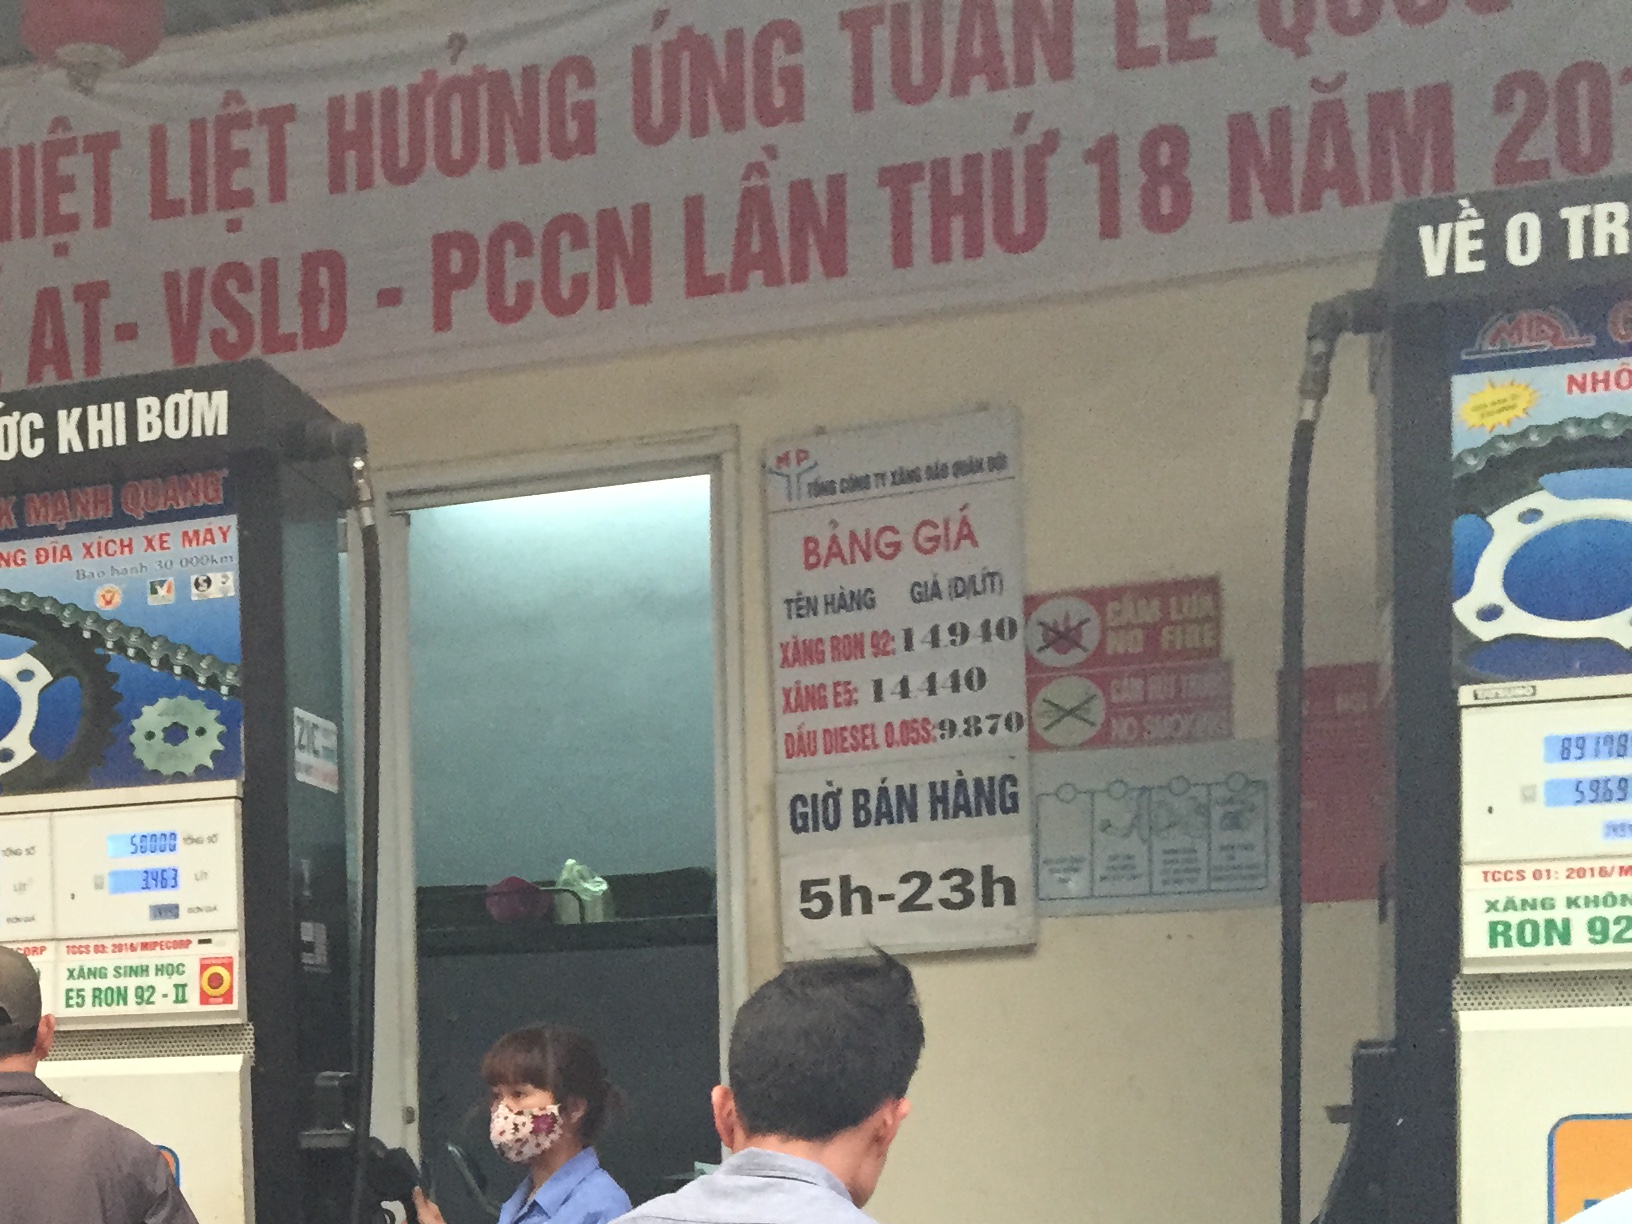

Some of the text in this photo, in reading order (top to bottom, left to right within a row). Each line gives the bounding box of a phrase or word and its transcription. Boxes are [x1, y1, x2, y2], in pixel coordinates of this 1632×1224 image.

[148, 88, 296, 234] LIỆT
[327, 32, 596, 196] HƯỞNG
[631, 8, 805, 147] ỨNG
[162, 248, 348, 367] VSLĐ
[432, 201, 652, 333] PCCN
[683, 143, 848, 300] LẦN
[876, 109, 1061, 270] THỨ
[1082, 122, 1193, 241] 18
[1227, 71, 1456, 223] NĂM
[1419, 197, 1487, 277] VỀ
[57, 401, 126, 454] KHI
[136, 388, 229, 443] BƠM
[120, 471, 225, 520] QUANG
[81, 533, 134, 561] XÍCH
[143, 532, 171, 552] XE
[181, 521, 232, 549] MÁY
[803, 502, 979, 571] BẢNG GIÁ
[784, 590, 819, 620] TÊN
[823, 586, 876, 615] HÀNG
[910, 571, 943, 604] GIÁ
[780, 634, 826, 669] XĂNG
[829, 632, 866, 662] RON
[782, 680, 828, 715] XĂNG
[872, 667, 987, 703] 14440
[784, 722, 818, 760] DẦU
[822, 723, 880, 755] DIESEL
[938, 711, 1025, 740] 9870
[789, 769, 1020, 835] GIỜ BÁN HÀNG
[799, 864, 1017, 920] 5h-23h
[1482, 869, 1526, 882] TCCS
[1485, 895, 1556, 914] XĂNG
[1488, 915, 1632, 949] RON 92
[66, 963, 186, 981] XĂNG SINH HỌC
[65, 988, 86, 1009] E5
[92, 986, 128, 1007] RON
[134, 985, 156, 1006] 92
